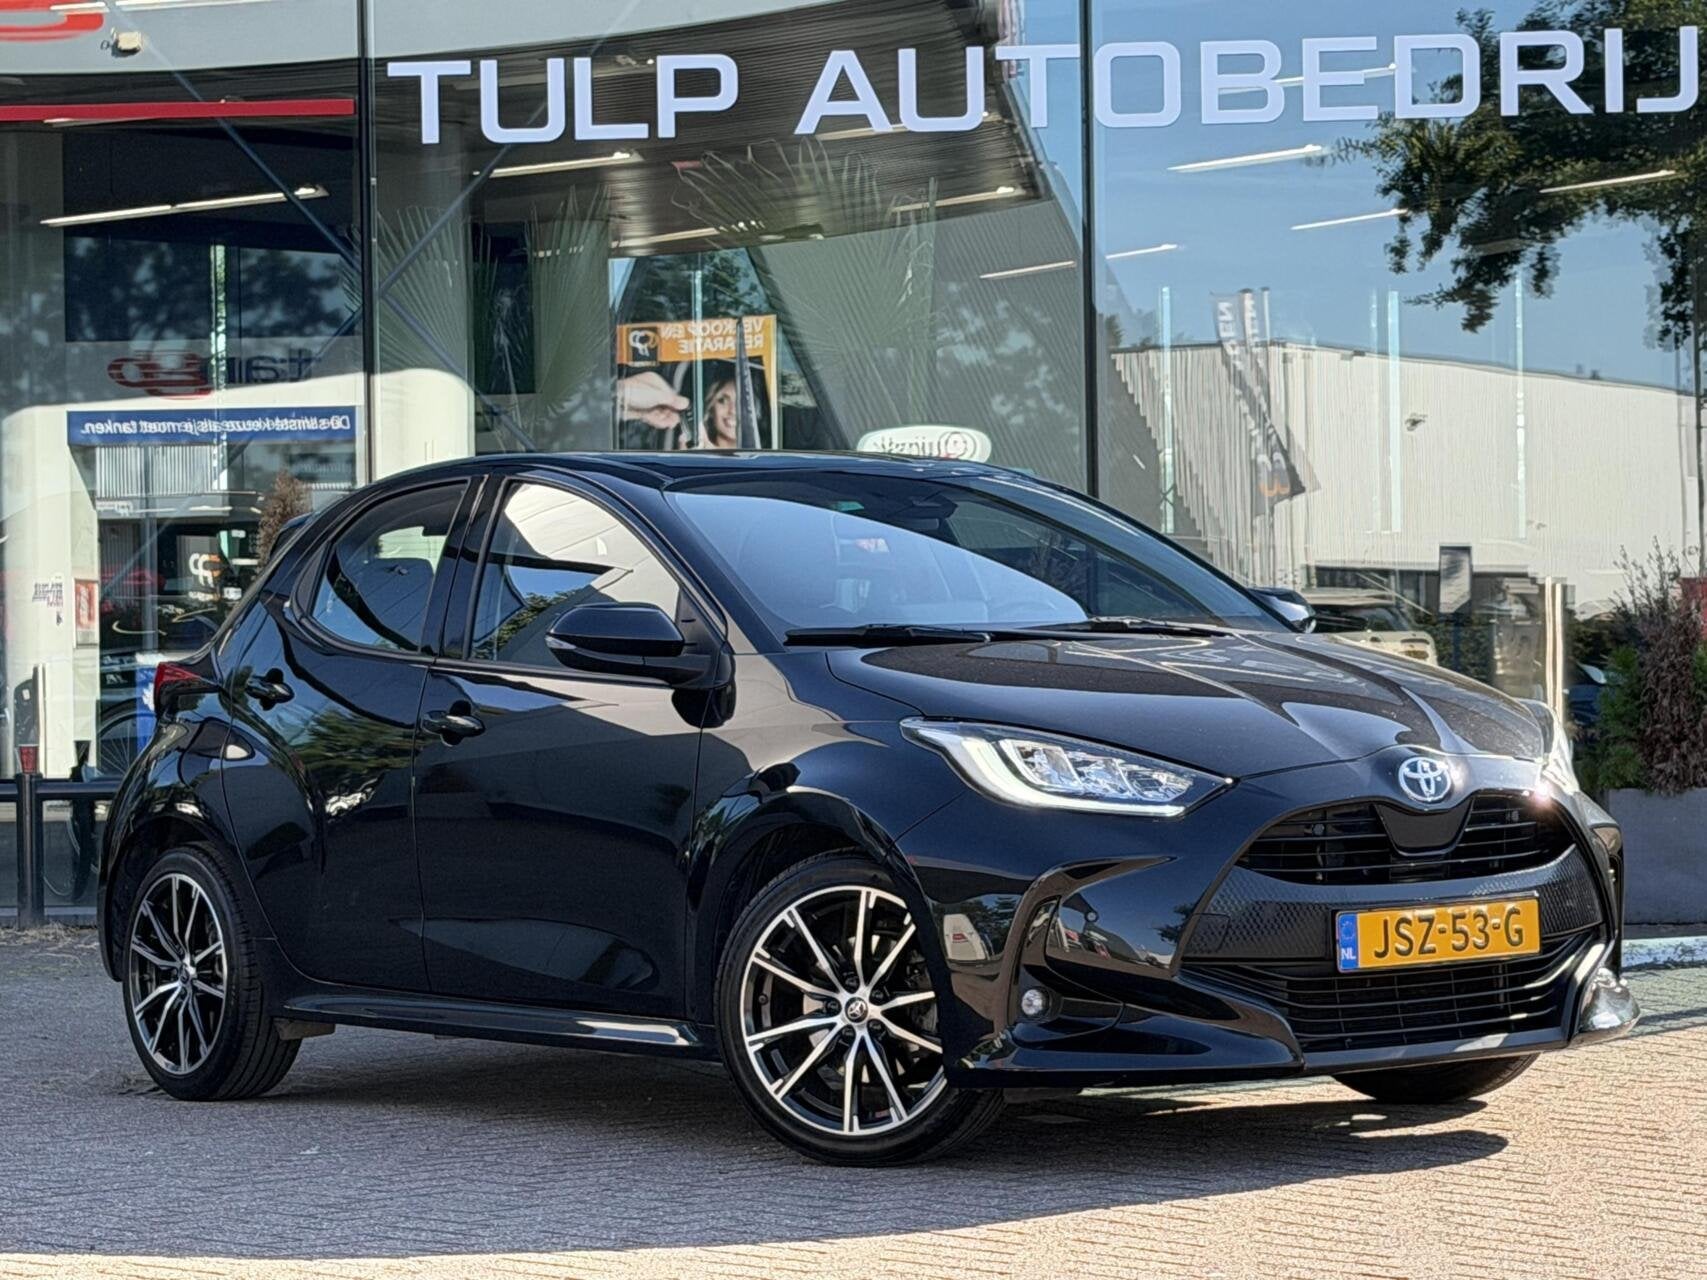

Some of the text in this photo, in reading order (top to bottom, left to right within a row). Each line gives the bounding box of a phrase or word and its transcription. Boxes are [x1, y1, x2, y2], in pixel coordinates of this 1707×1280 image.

[387, 26, 1698, 144] TULP AUTOBEDRIJ
[1340, 947, 1357, 960] NL
[1373, 905, 1524, 959] JSZ-53-G
